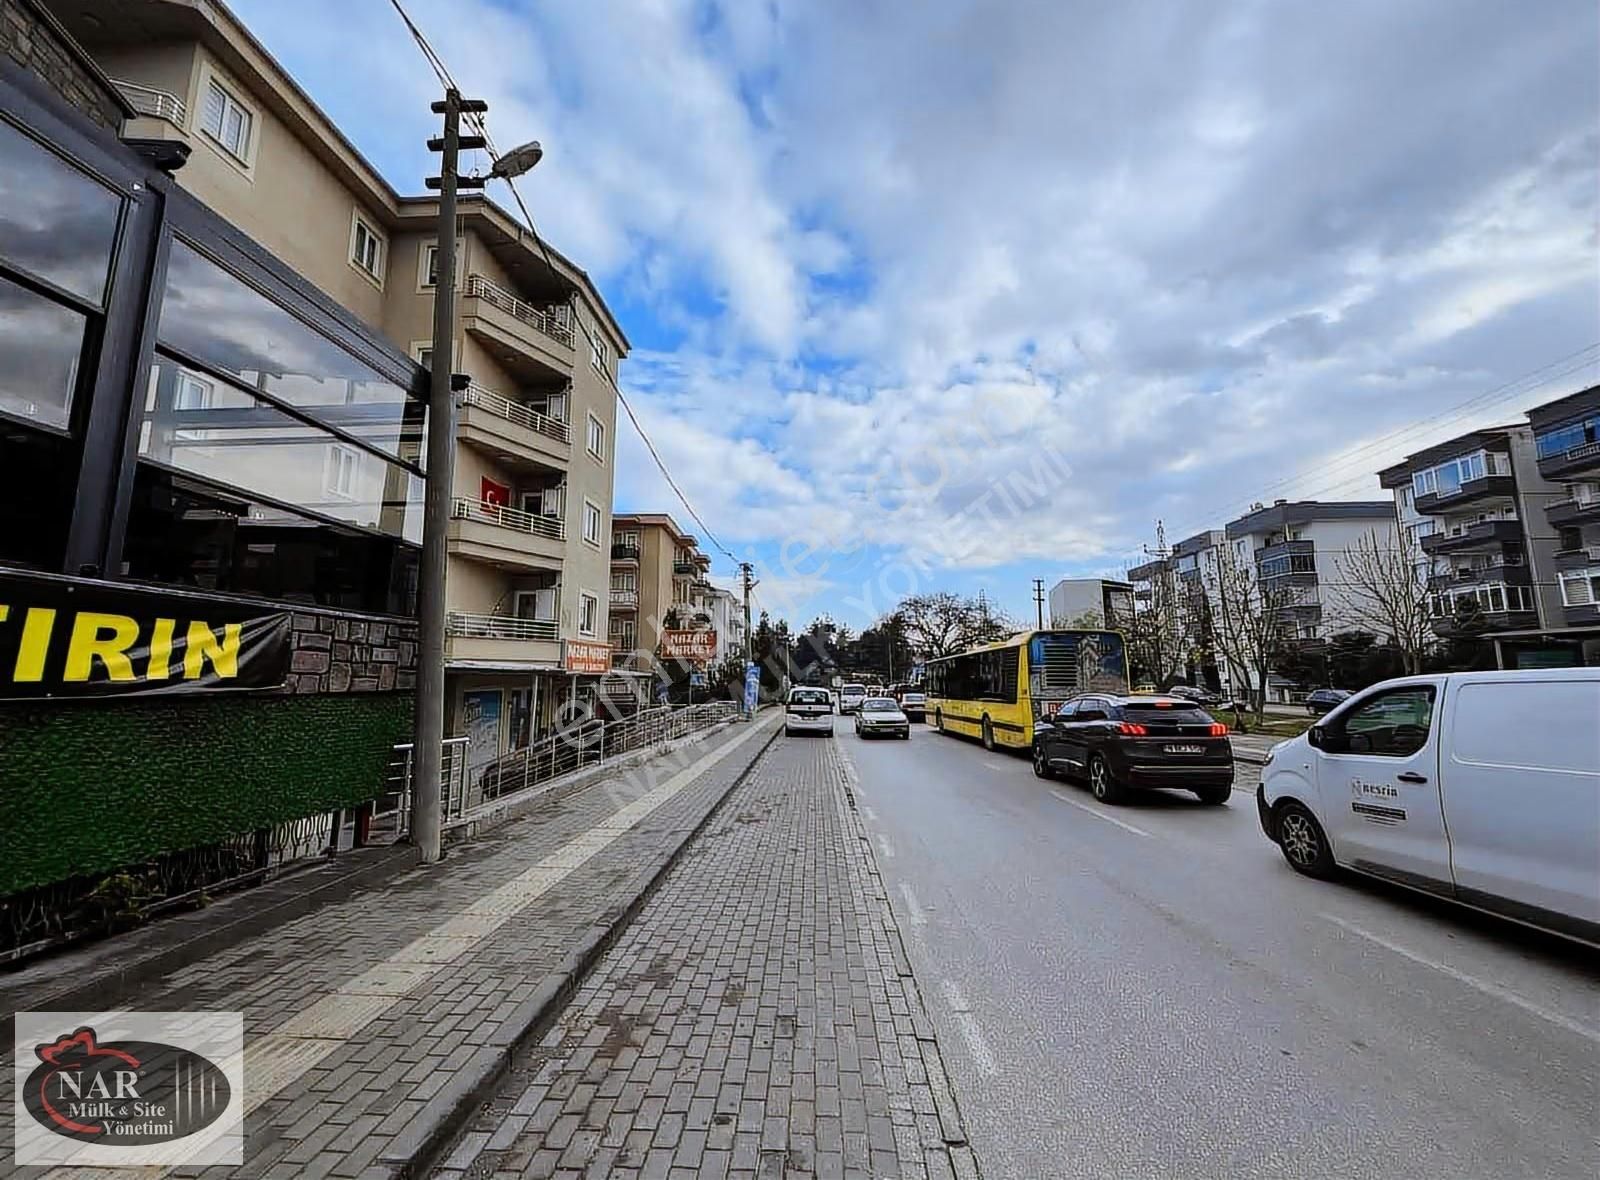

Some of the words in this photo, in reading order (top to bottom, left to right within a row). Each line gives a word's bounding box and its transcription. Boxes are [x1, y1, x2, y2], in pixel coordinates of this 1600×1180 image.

[0, 604, 242, 682] IRIN
[671, 634, 710, 646] NAZAR
[666, 646, 712, 658] MARKET
